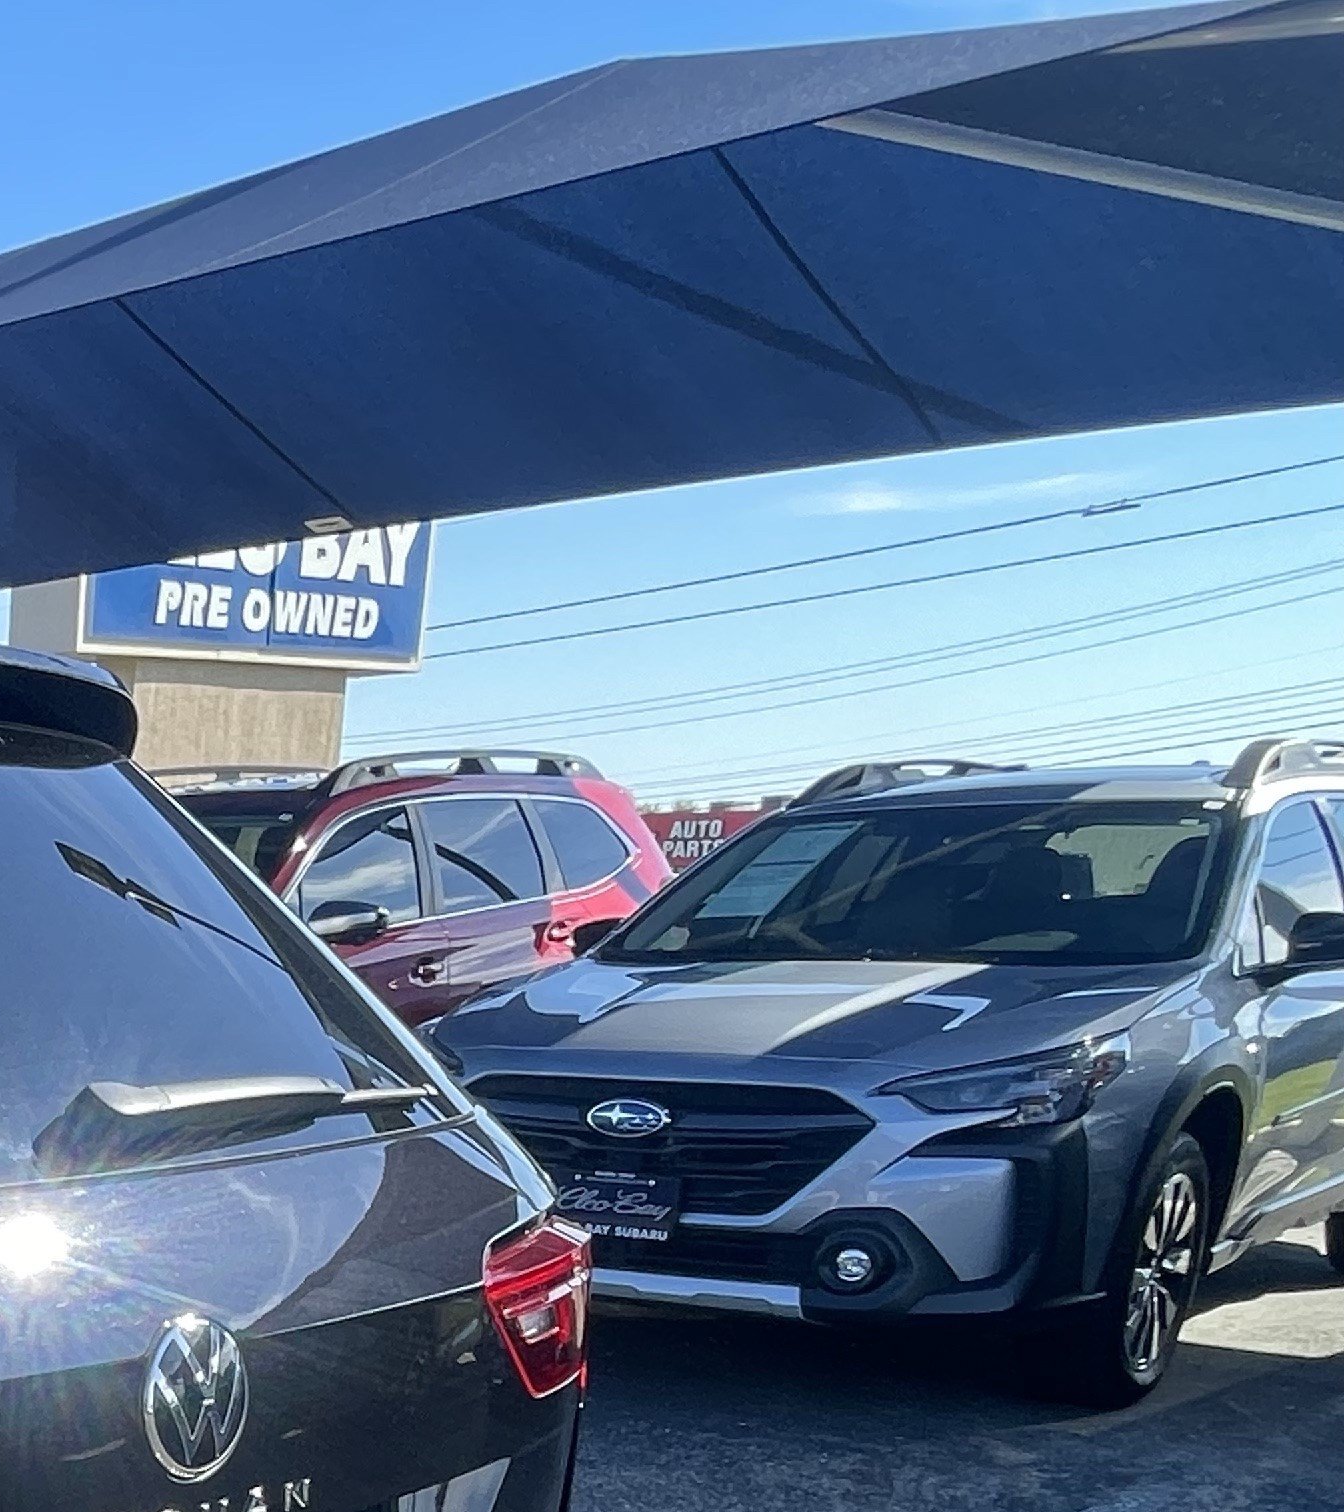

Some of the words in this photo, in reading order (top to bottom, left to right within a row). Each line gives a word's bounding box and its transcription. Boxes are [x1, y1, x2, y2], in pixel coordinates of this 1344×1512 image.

[300, 522, 420, 587] BAY
[154, 578, 233, 629] PRE
[242, 587, 379, 640] OWNED
[669, 819, 724, 838] AUTO
[614, 1226, 668, 1241] SUBARU
